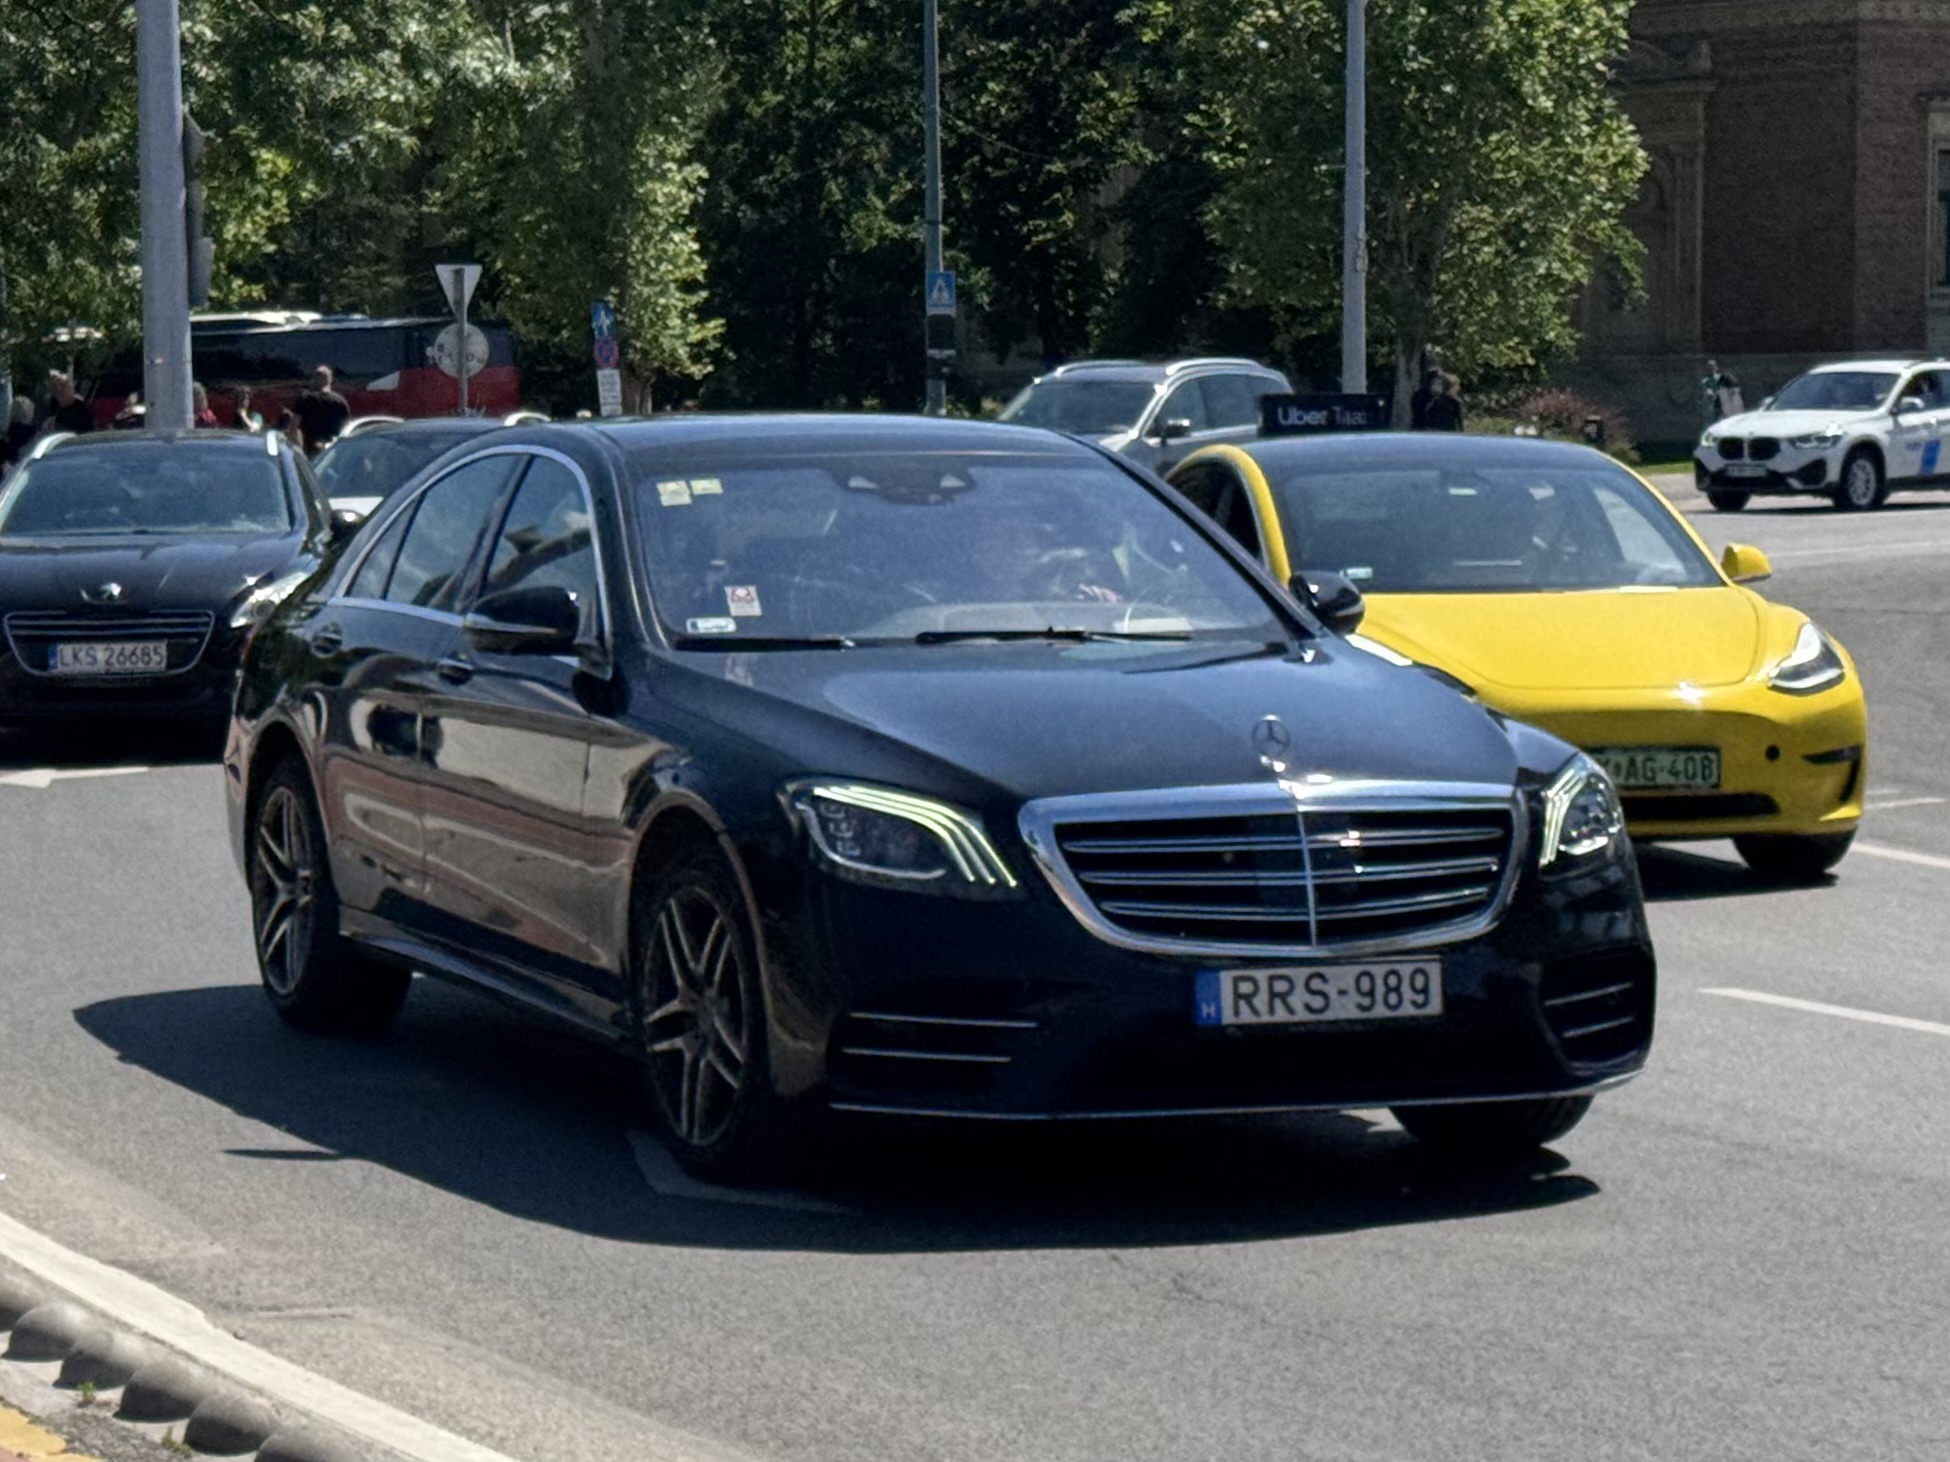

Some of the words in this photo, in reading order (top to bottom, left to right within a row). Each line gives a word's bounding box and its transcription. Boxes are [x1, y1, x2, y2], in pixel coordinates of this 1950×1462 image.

[1277, 405, 1328, 426] Uber
[59, 645, 98, 667] LKS
[104, 644, 164, 667] 26685
[1231, 967, 1431, 1018] RRS-989
